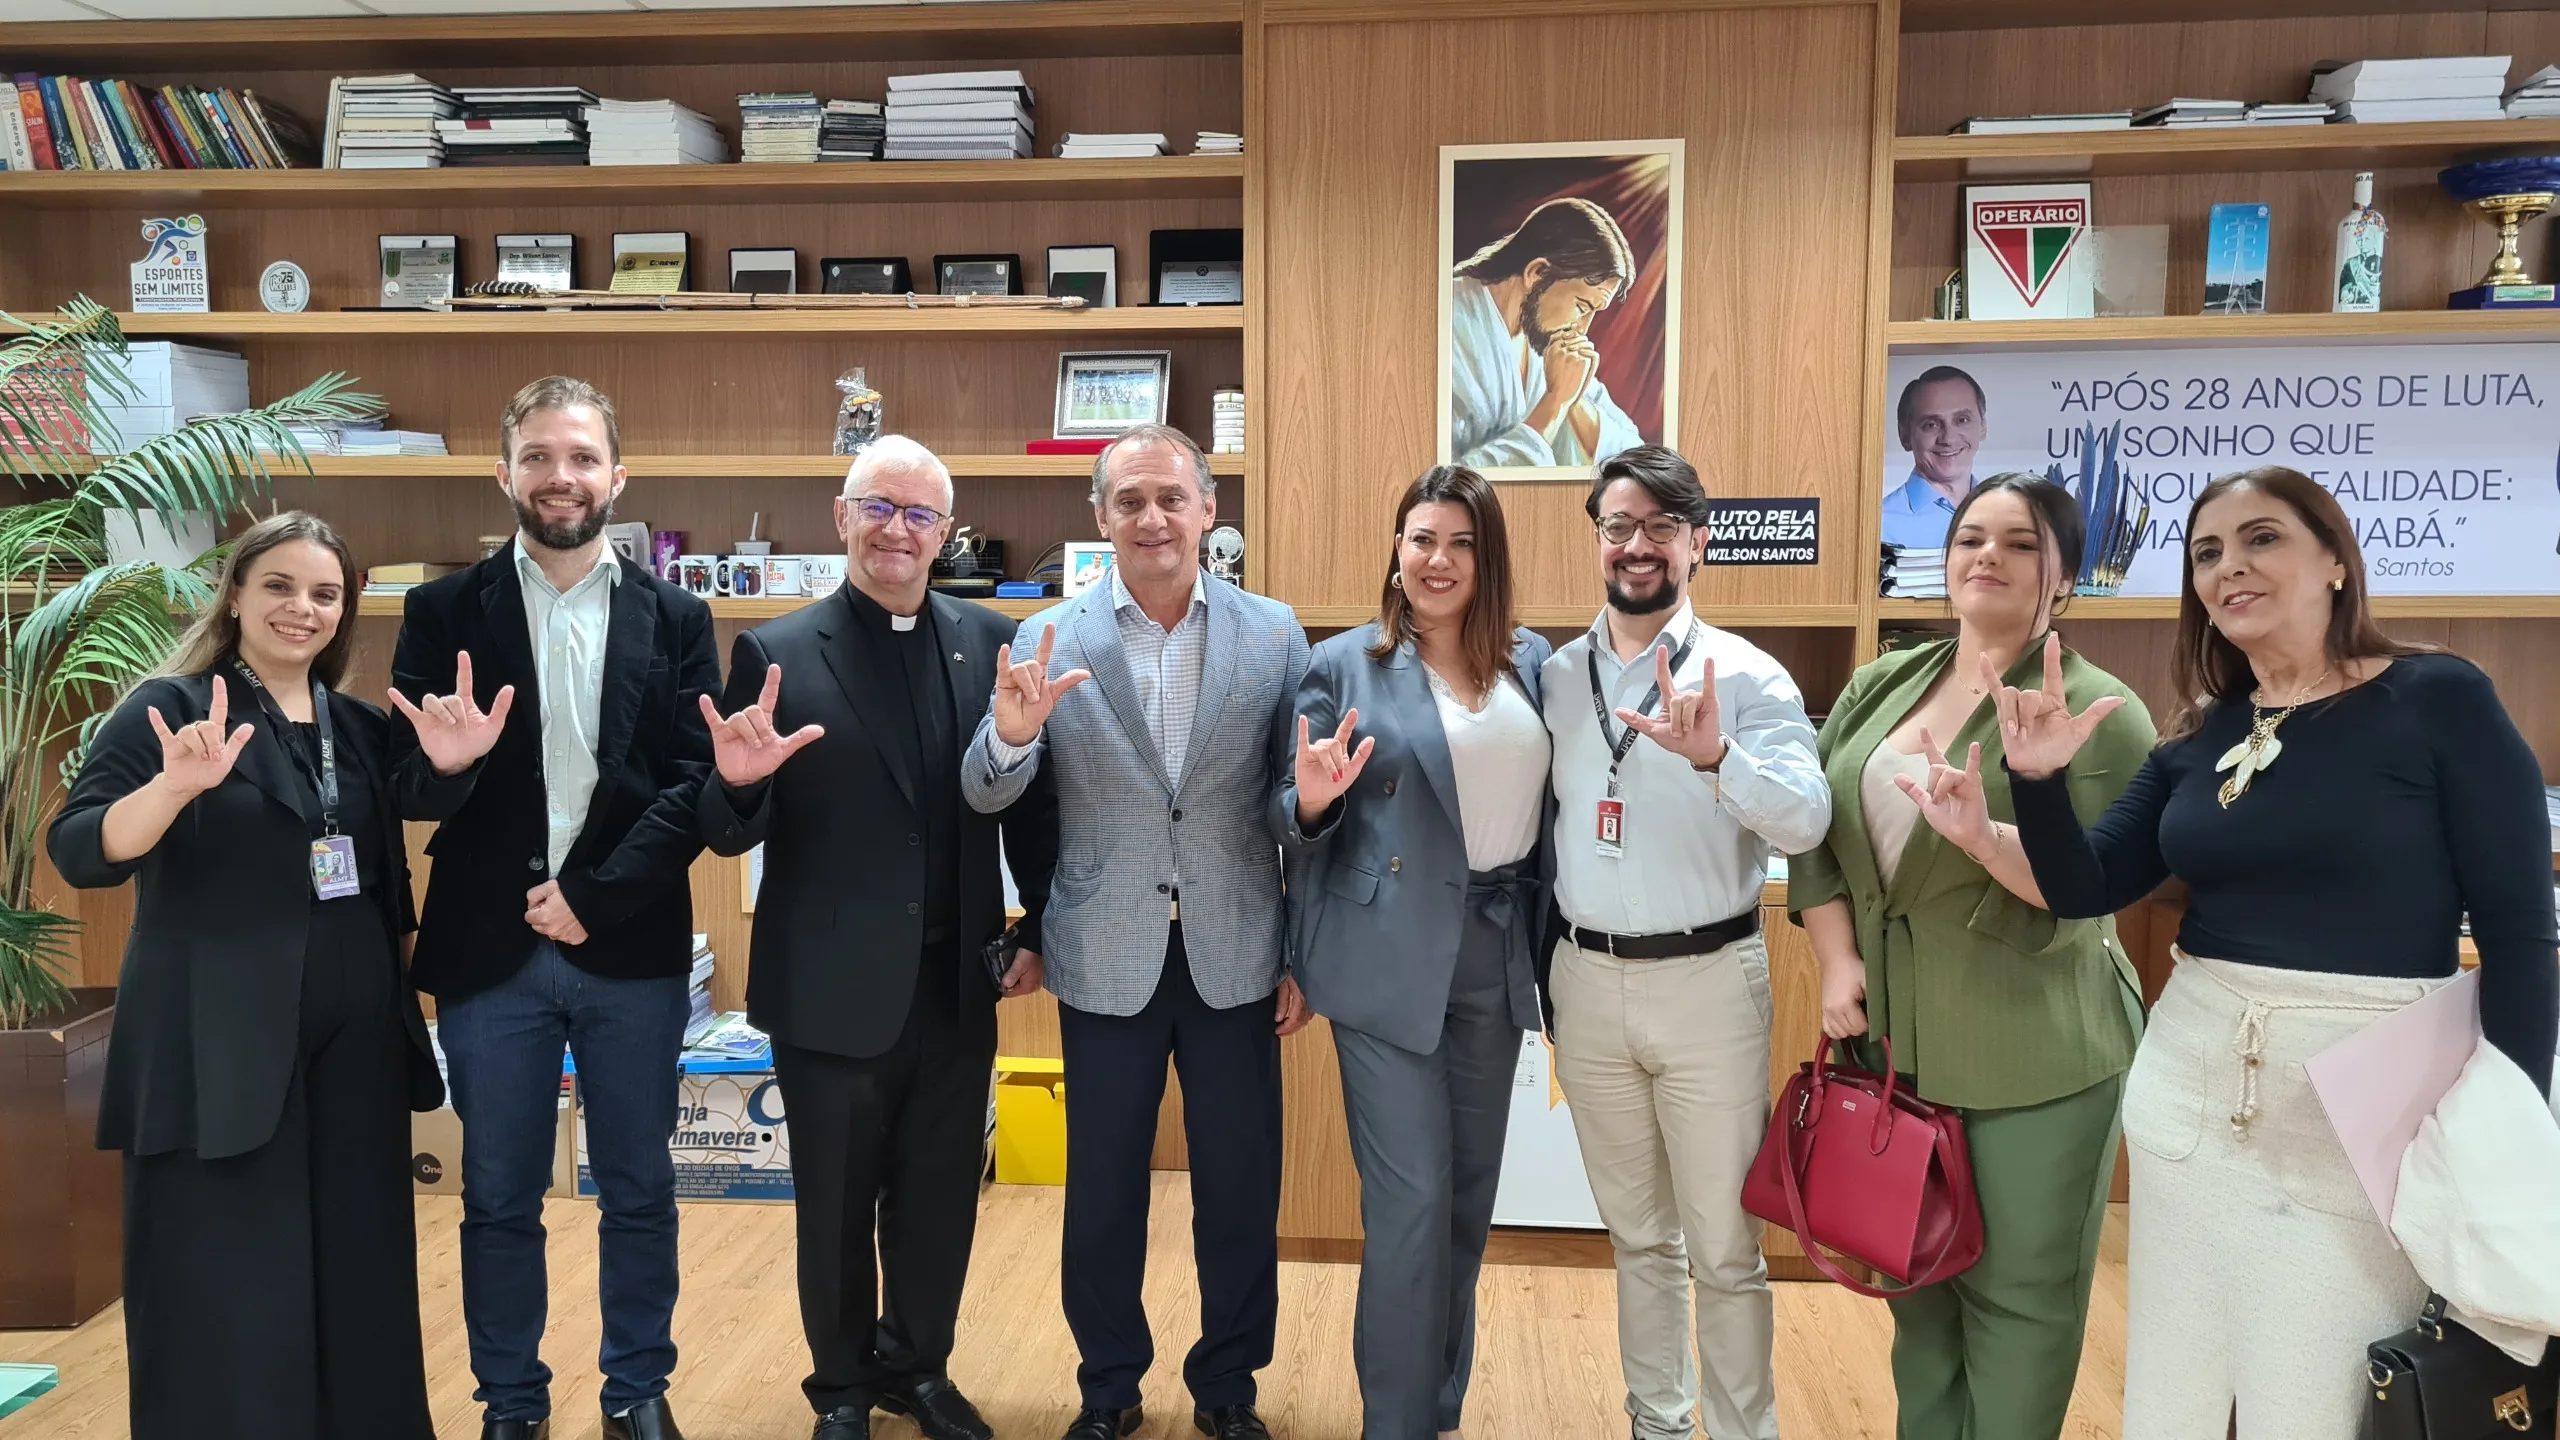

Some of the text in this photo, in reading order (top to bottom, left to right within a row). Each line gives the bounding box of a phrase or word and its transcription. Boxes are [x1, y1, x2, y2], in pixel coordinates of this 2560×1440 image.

[9, 112, 21, 147] Saraiva
[1980, 206, 2079, 223] OPERÁRIO
[145, 268, 204, 281] ESPORTES
[134, 283, 204, 296] SEM LIMITES
[2184, 377, 2231, 411] 28
[2241, 375, 2363, 410] ANOS
[2377, 374, 2430, 408] DE
[2443, 373, 2545, 409] LUTA,
[2122, 424, 2275, 458] SONHO
[2289, 423, 2375, 456] QUE
[2309, 469, 2513, 502] EALIDADE:
[1708, 509, 1816, 526] LUTO PELA
[1708, 525, 1816, 541] NATUREZA
[1707, 547, 1815, 561] WILSON SANTOS
[2373, 556, 2455, 577] Santos
[241, 667, 264, 689] ALMT
[321, 738, 331, 760] ALMT
[1620, 729, 1637, 755] ALMT
[329, 875, 349, 884] ALMT
[678, 1103, 708, 1125] nja
[671, 1129, 757, 1147] imavera
